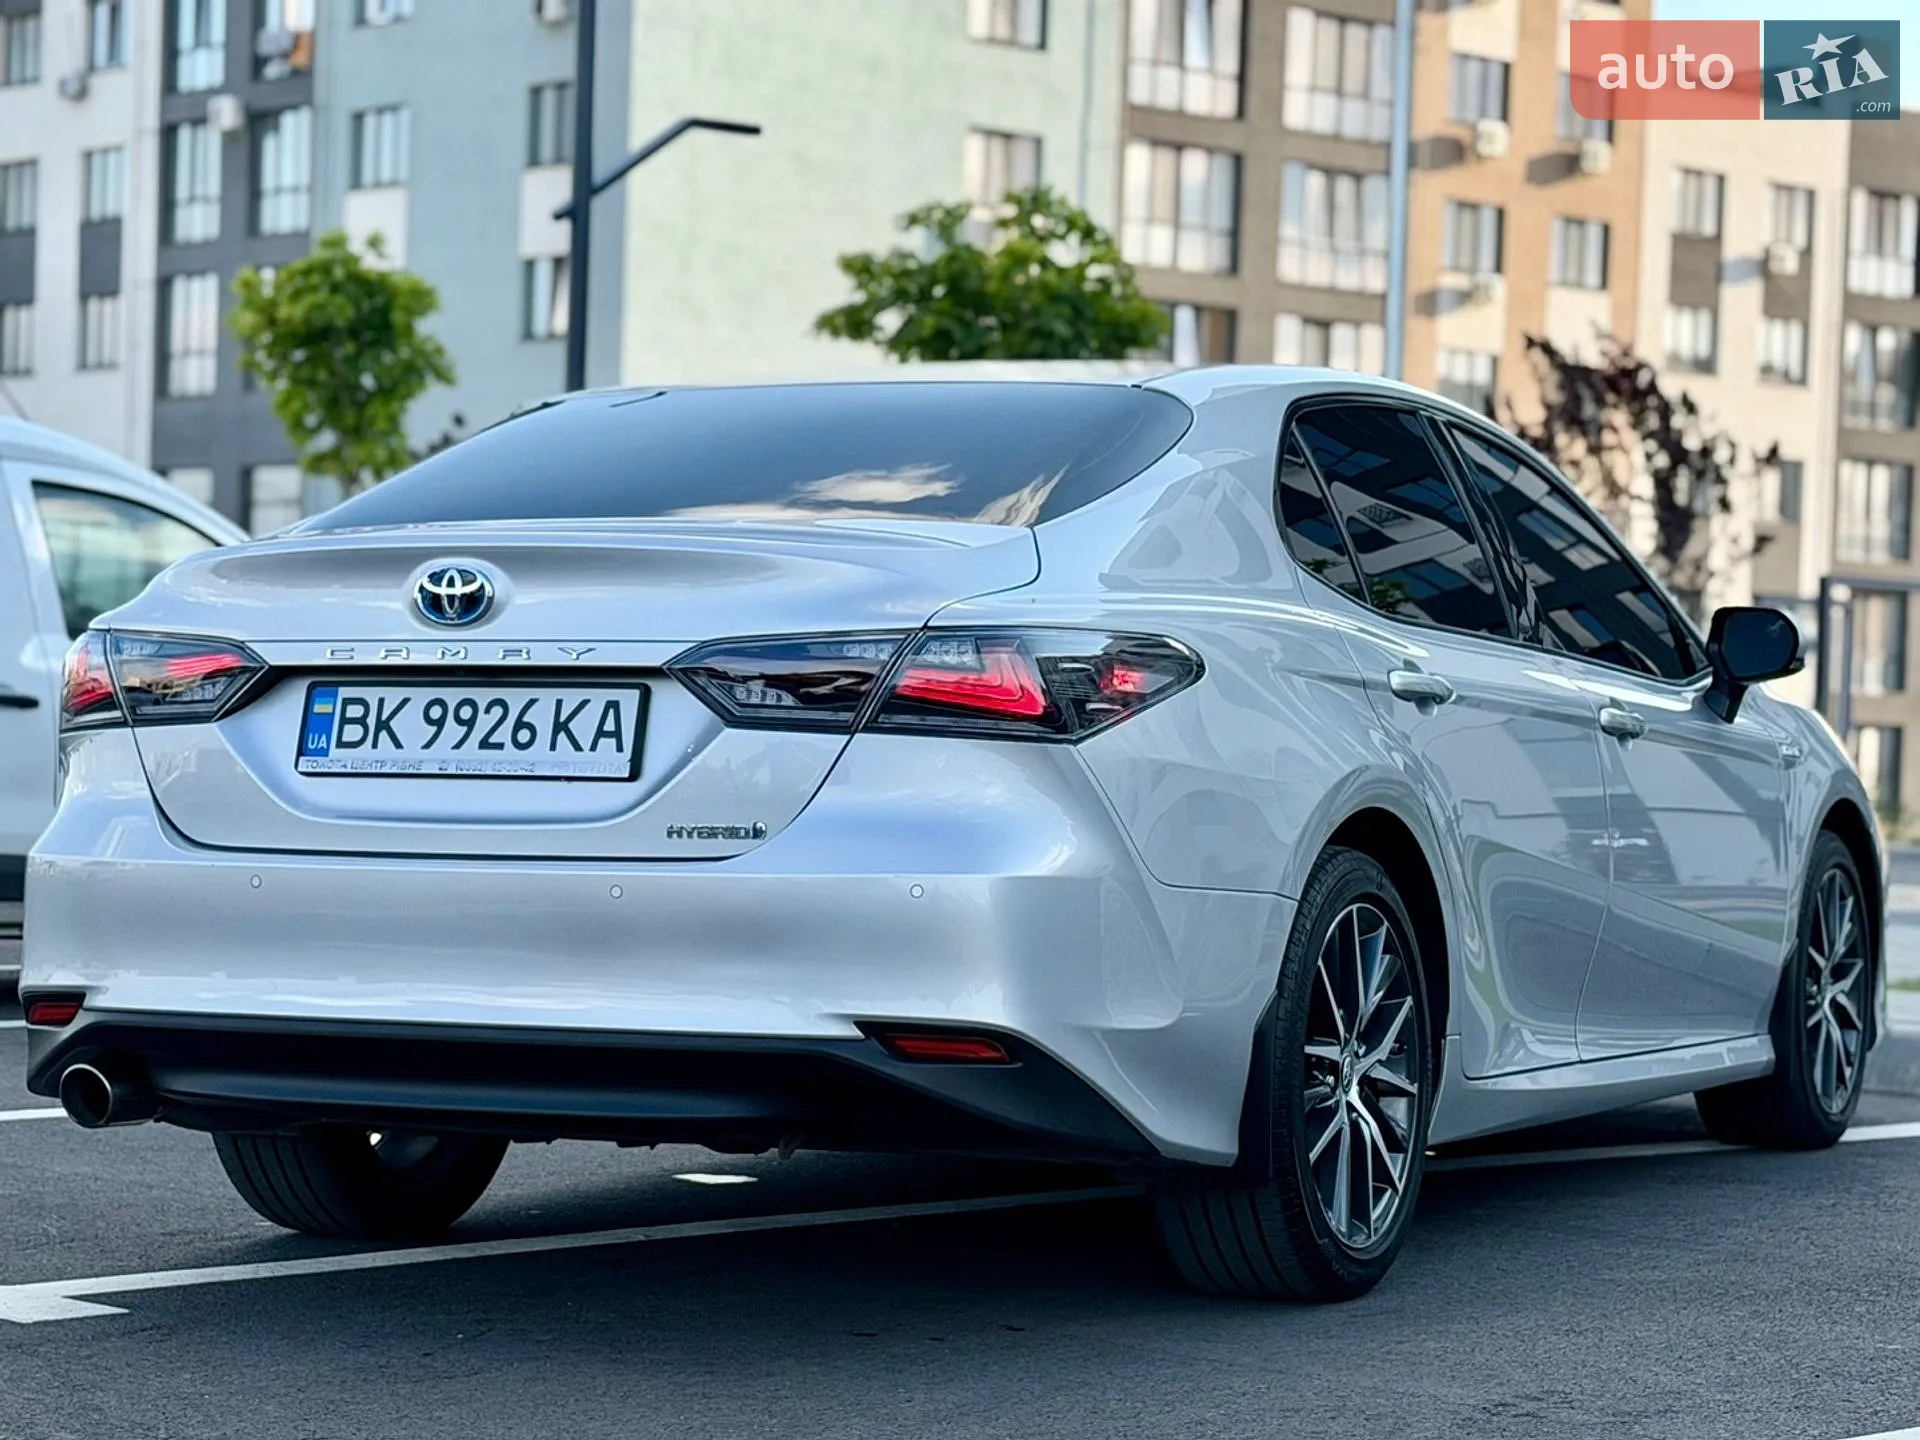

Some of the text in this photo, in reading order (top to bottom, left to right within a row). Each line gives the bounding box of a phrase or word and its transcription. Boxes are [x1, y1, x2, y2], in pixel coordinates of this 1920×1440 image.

[325, 647, 597, 661] CAMRY
[335, 696, 625, 753] BK 9926 KA
[308, 733, 328, 750] UA
[666, 824, 751, 840] HYBRID
